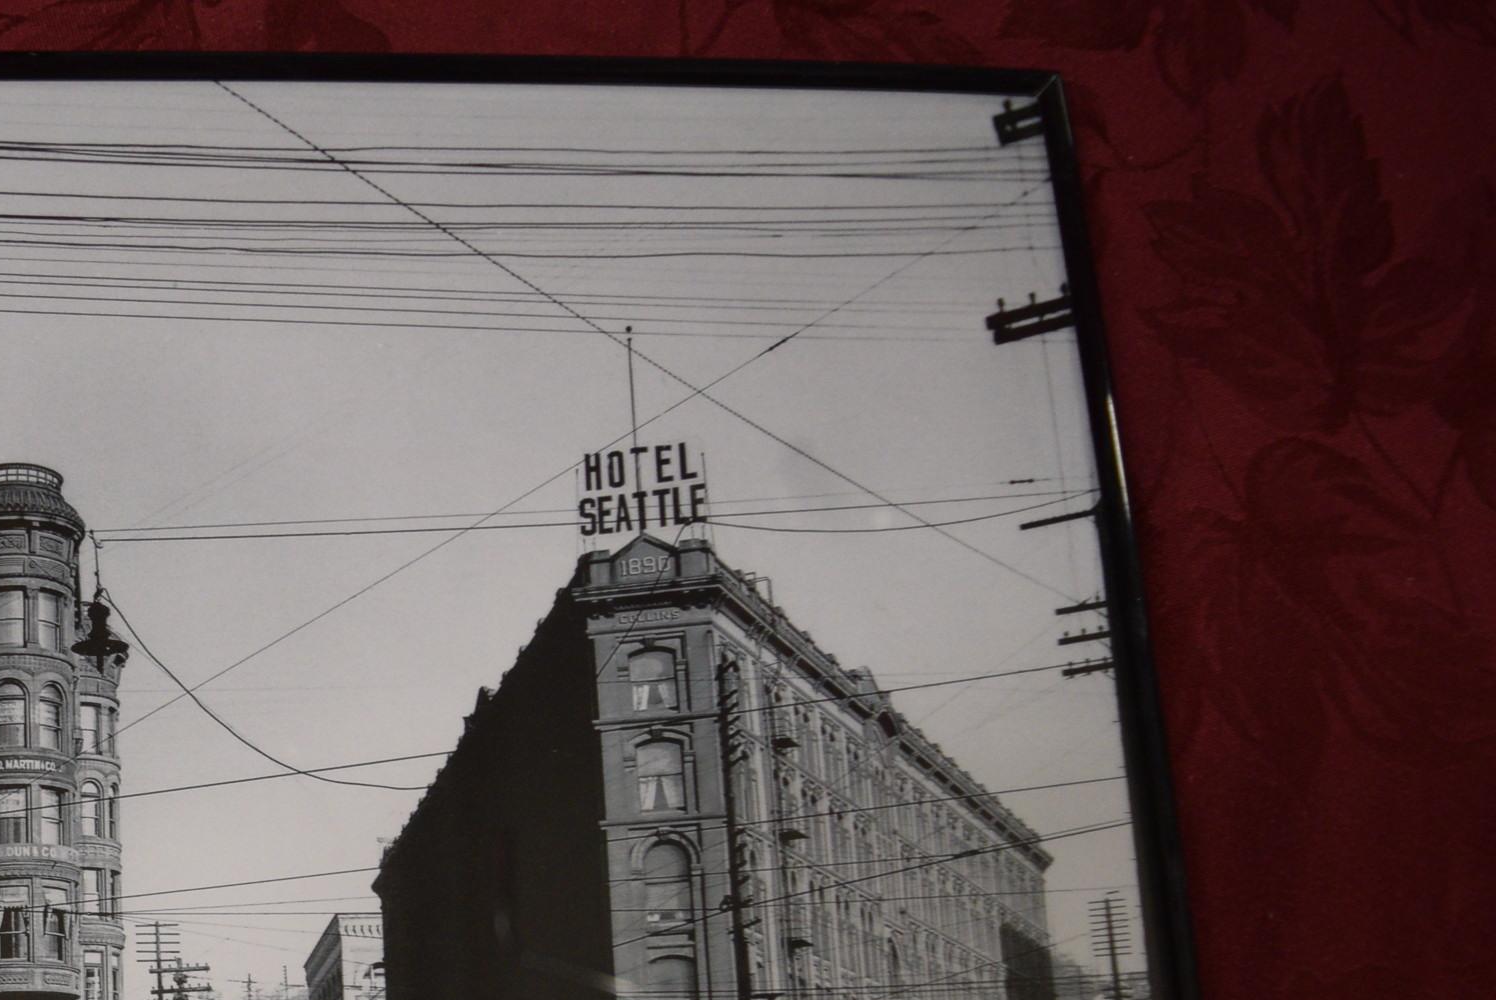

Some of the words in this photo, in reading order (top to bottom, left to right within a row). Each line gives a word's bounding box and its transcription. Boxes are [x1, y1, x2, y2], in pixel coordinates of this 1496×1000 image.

[584, 442, 698, 491] HOTEL
[579, 483, 706, 536] SEATTLE
[620, 555, 672, 576] 1890
[618, 608, 681, 624] COLLINS
